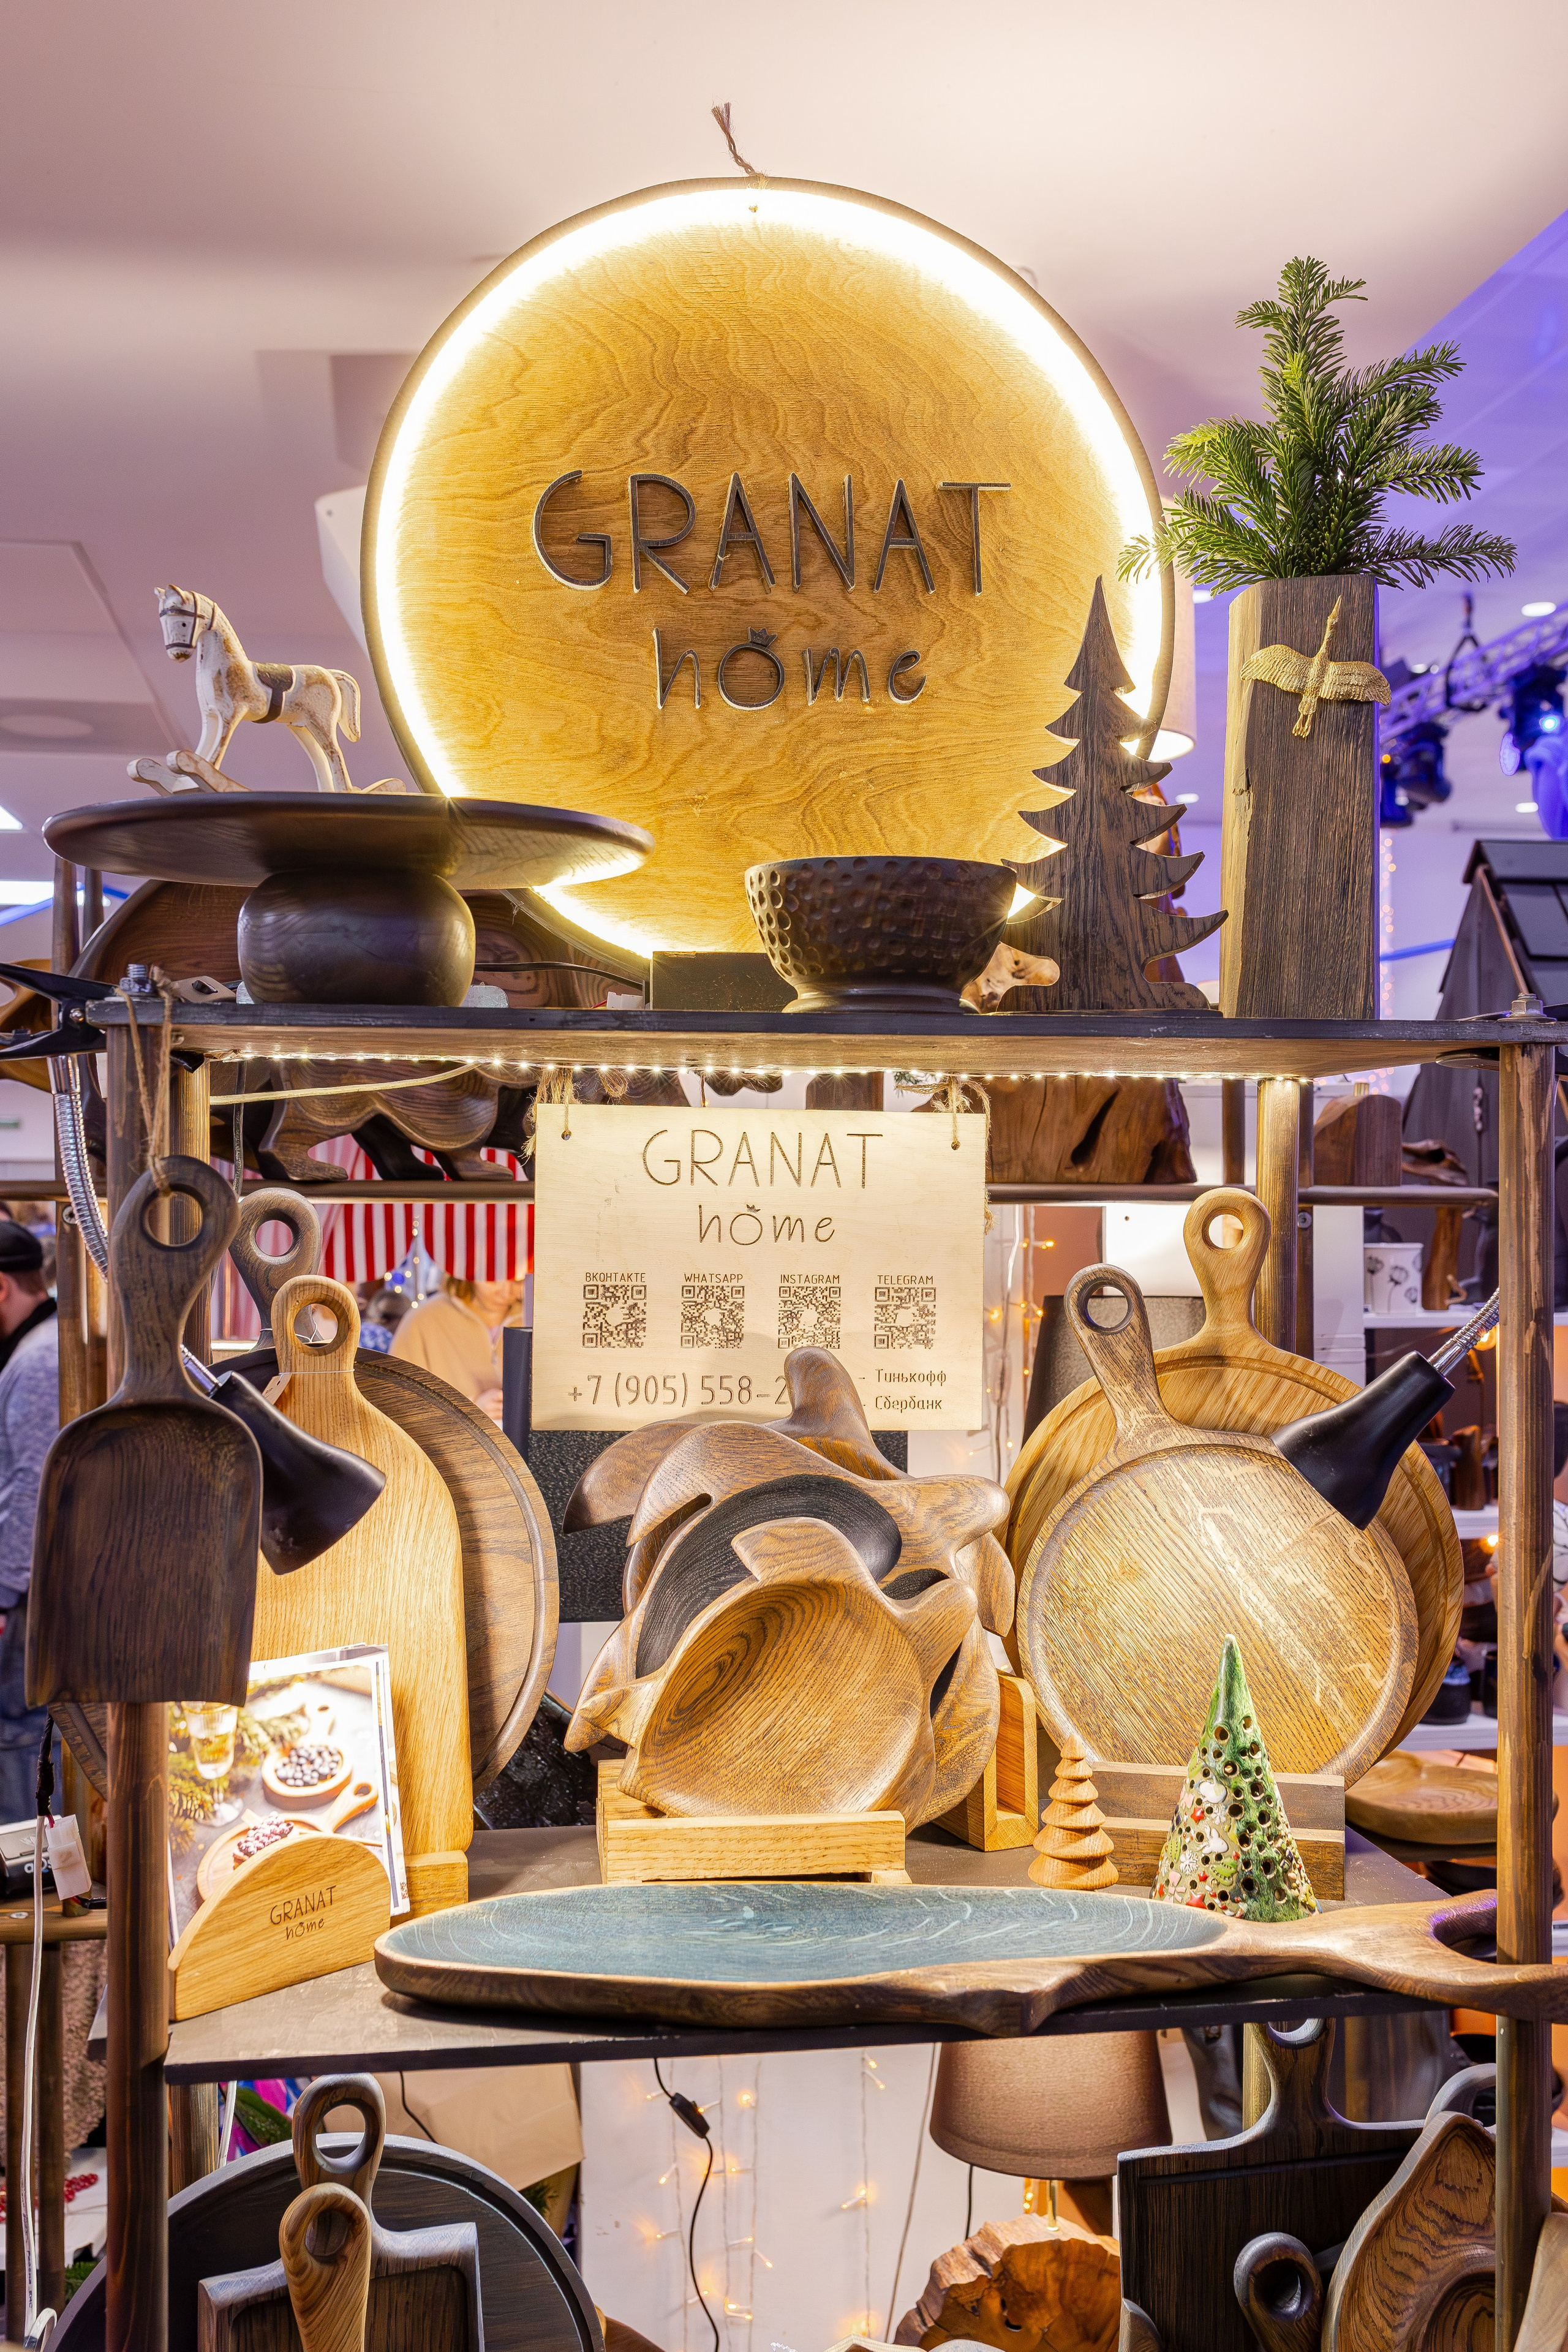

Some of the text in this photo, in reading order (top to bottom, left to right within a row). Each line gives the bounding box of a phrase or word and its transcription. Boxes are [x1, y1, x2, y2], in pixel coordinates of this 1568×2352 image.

[532, 469, 1012, 597] GRANAT
[652, 626, 927, 711] home
[642, 1129, 883, 1189] GRANAT
[698, 1204, 835, 1246] home
[584, 1272, 646, 1283] ВКОНТАКТЕ
[684, 1273, 744, 1284] WHATSAPP
[780, 1274, 840, 1284] INSTAGRAM
[876, 1275, 934, 1285] TELEGRAM
[875, 1368, 947, 1387] Тинькофф
[568, 1372, 790, 1408] +7 (905) 558-2
[875, 1395, 943, 1414] Сбербанк
[270, 1885, 337, 1925] GRANAT
[285, 1918, 325, 1940] home
